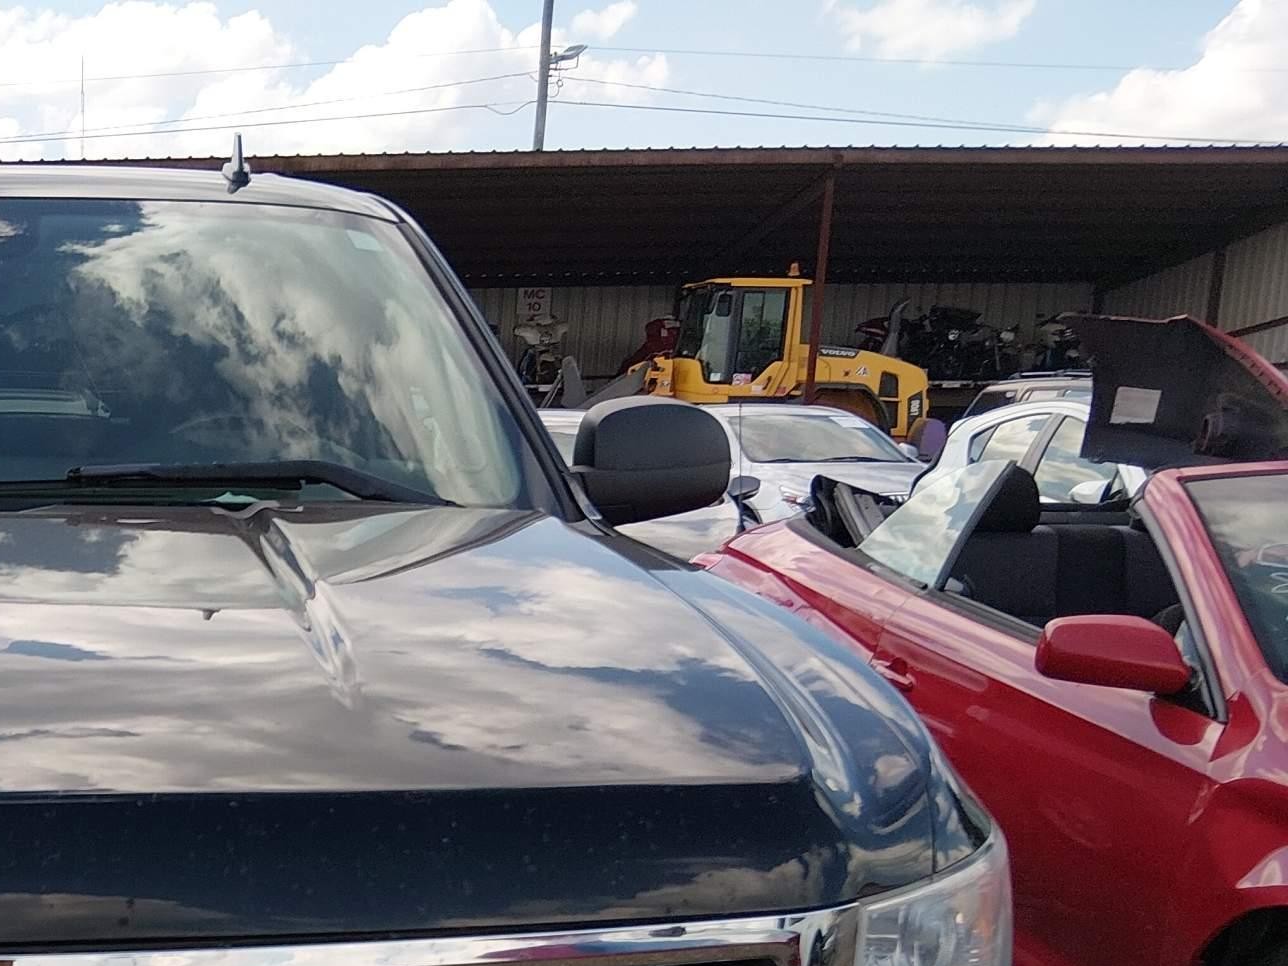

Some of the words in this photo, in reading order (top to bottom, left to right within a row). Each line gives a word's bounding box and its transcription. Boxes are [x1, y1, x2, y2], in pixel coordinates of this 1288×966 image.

[523, 289, 545, 299] MC
[527, 302, 541, 311] 10
[820, 348, 856, 357] VOLVO
